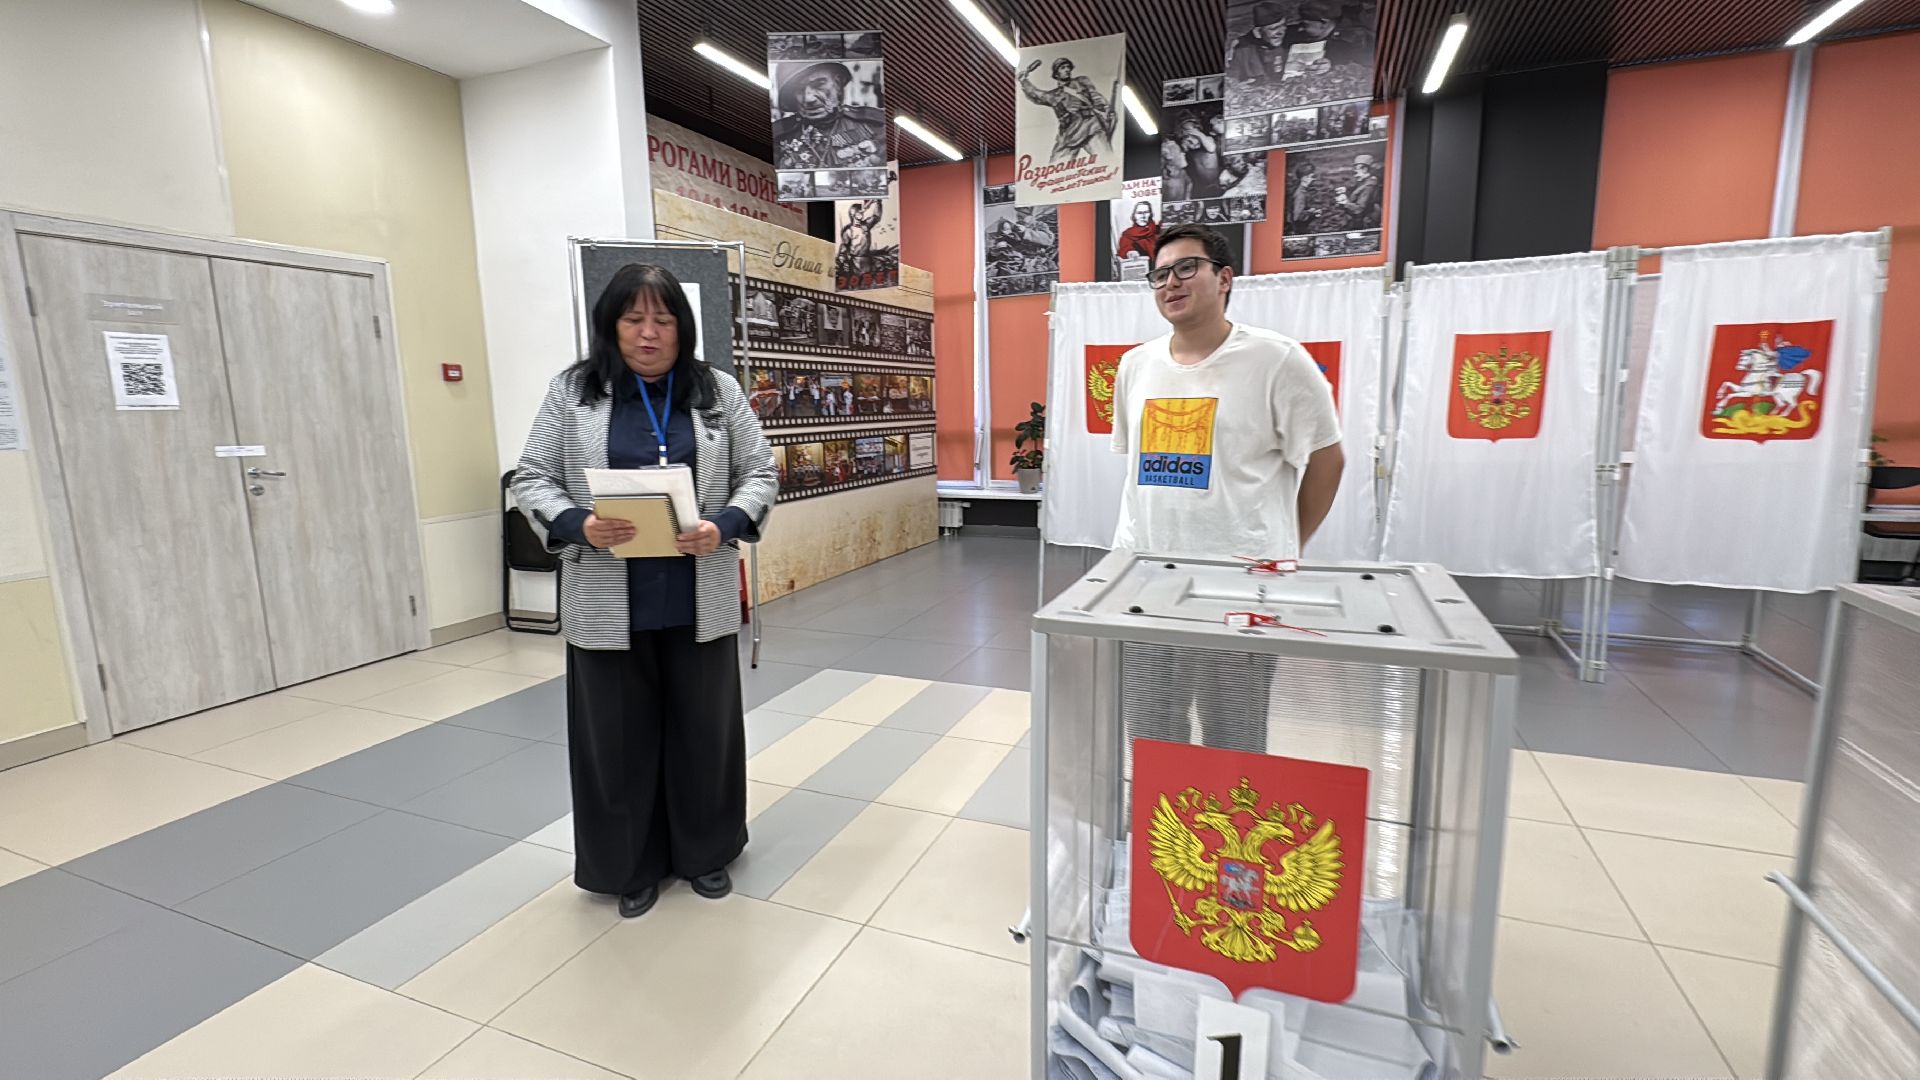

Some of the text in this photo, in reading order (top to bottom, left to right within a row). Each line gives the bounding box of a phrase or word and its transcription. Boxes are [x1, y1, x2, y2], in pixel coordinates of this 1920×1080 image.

[1131, 187, 1162, 198] ЗОВЕ
[772, 241, 822, 274] Наша
[1143, 456, 1204, 475] adidas
[1145, 475, 1195, 485] BASKETBALL
